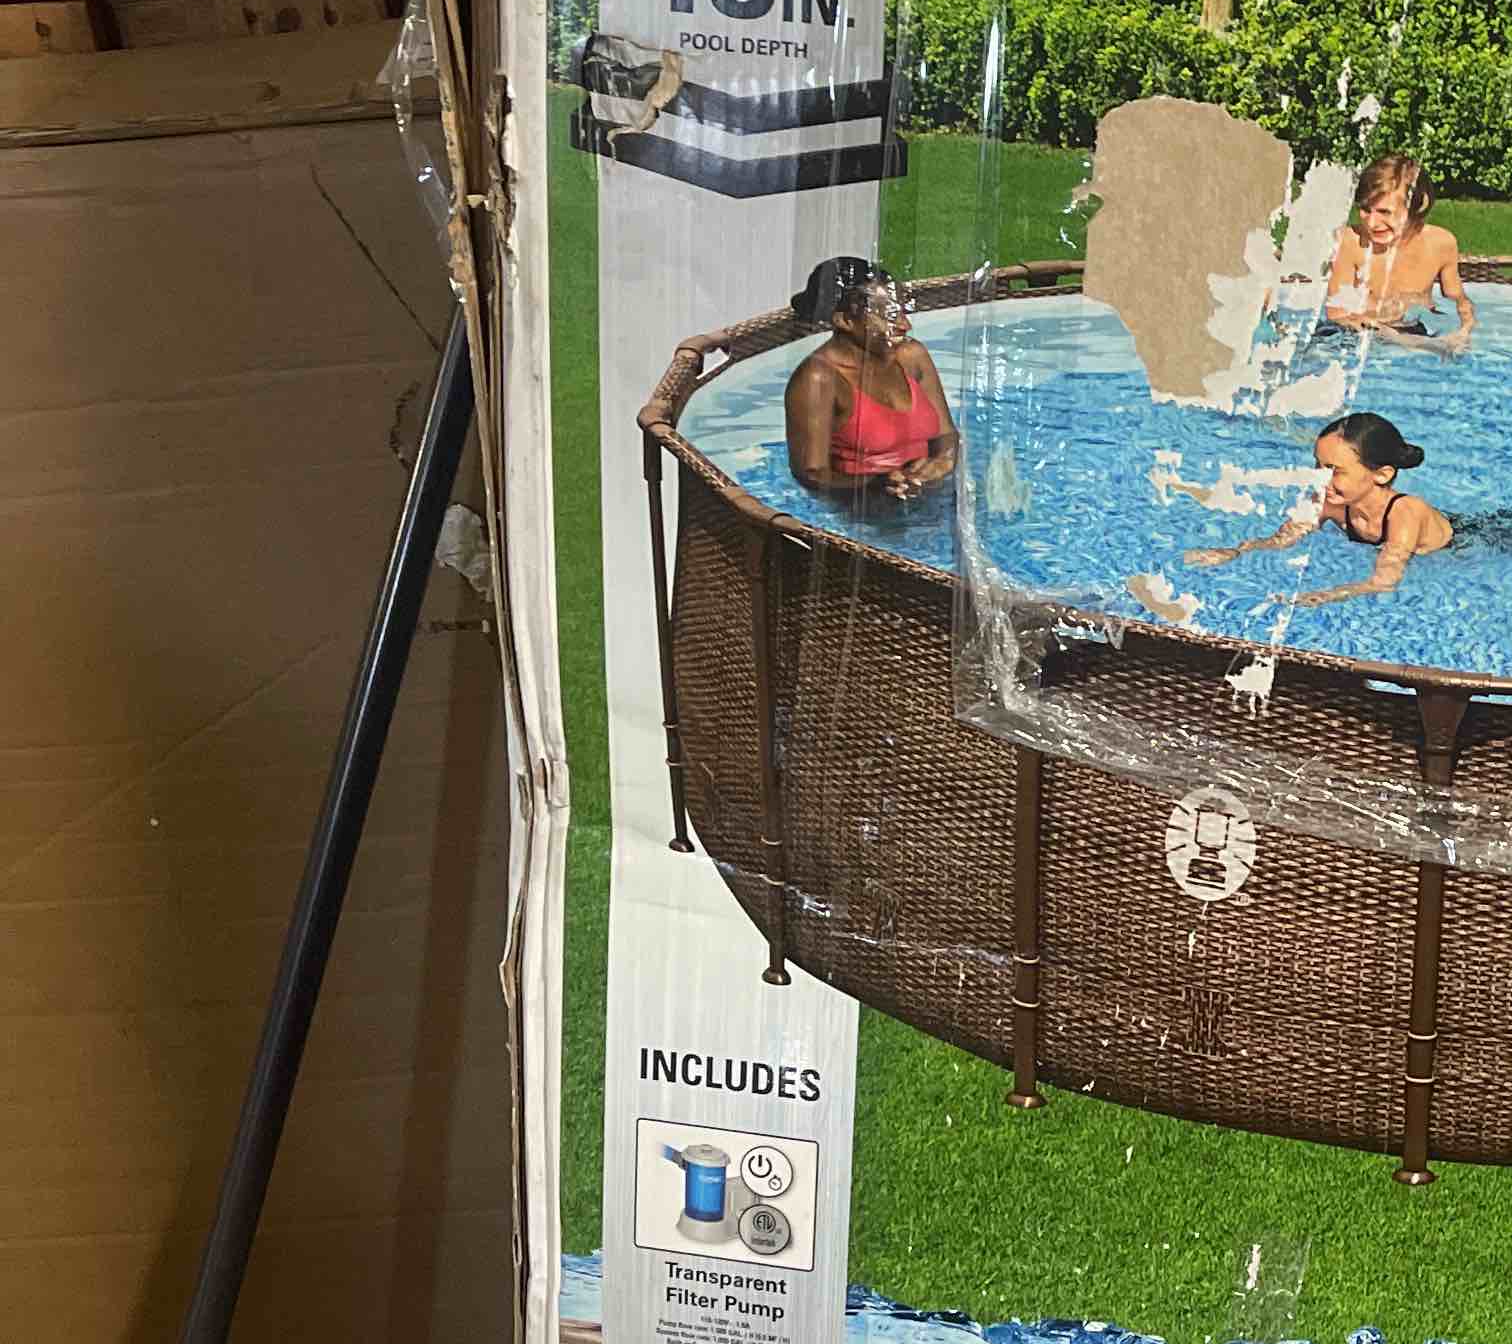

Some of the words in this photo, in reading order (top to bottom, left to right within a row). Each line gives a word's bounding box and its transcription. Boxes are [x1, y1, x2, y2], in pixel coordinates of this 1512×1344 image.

[679, 31, 734, 54] POOL
[741, 36, 809, 60] DEPTH
[639, 1047, 822, 1103] INCLUDES
[665, 1261, 788, 1295] Transparent
[666, 1286, 718, 1309] Filter
[725, 1295, 785, 1323] Pump
